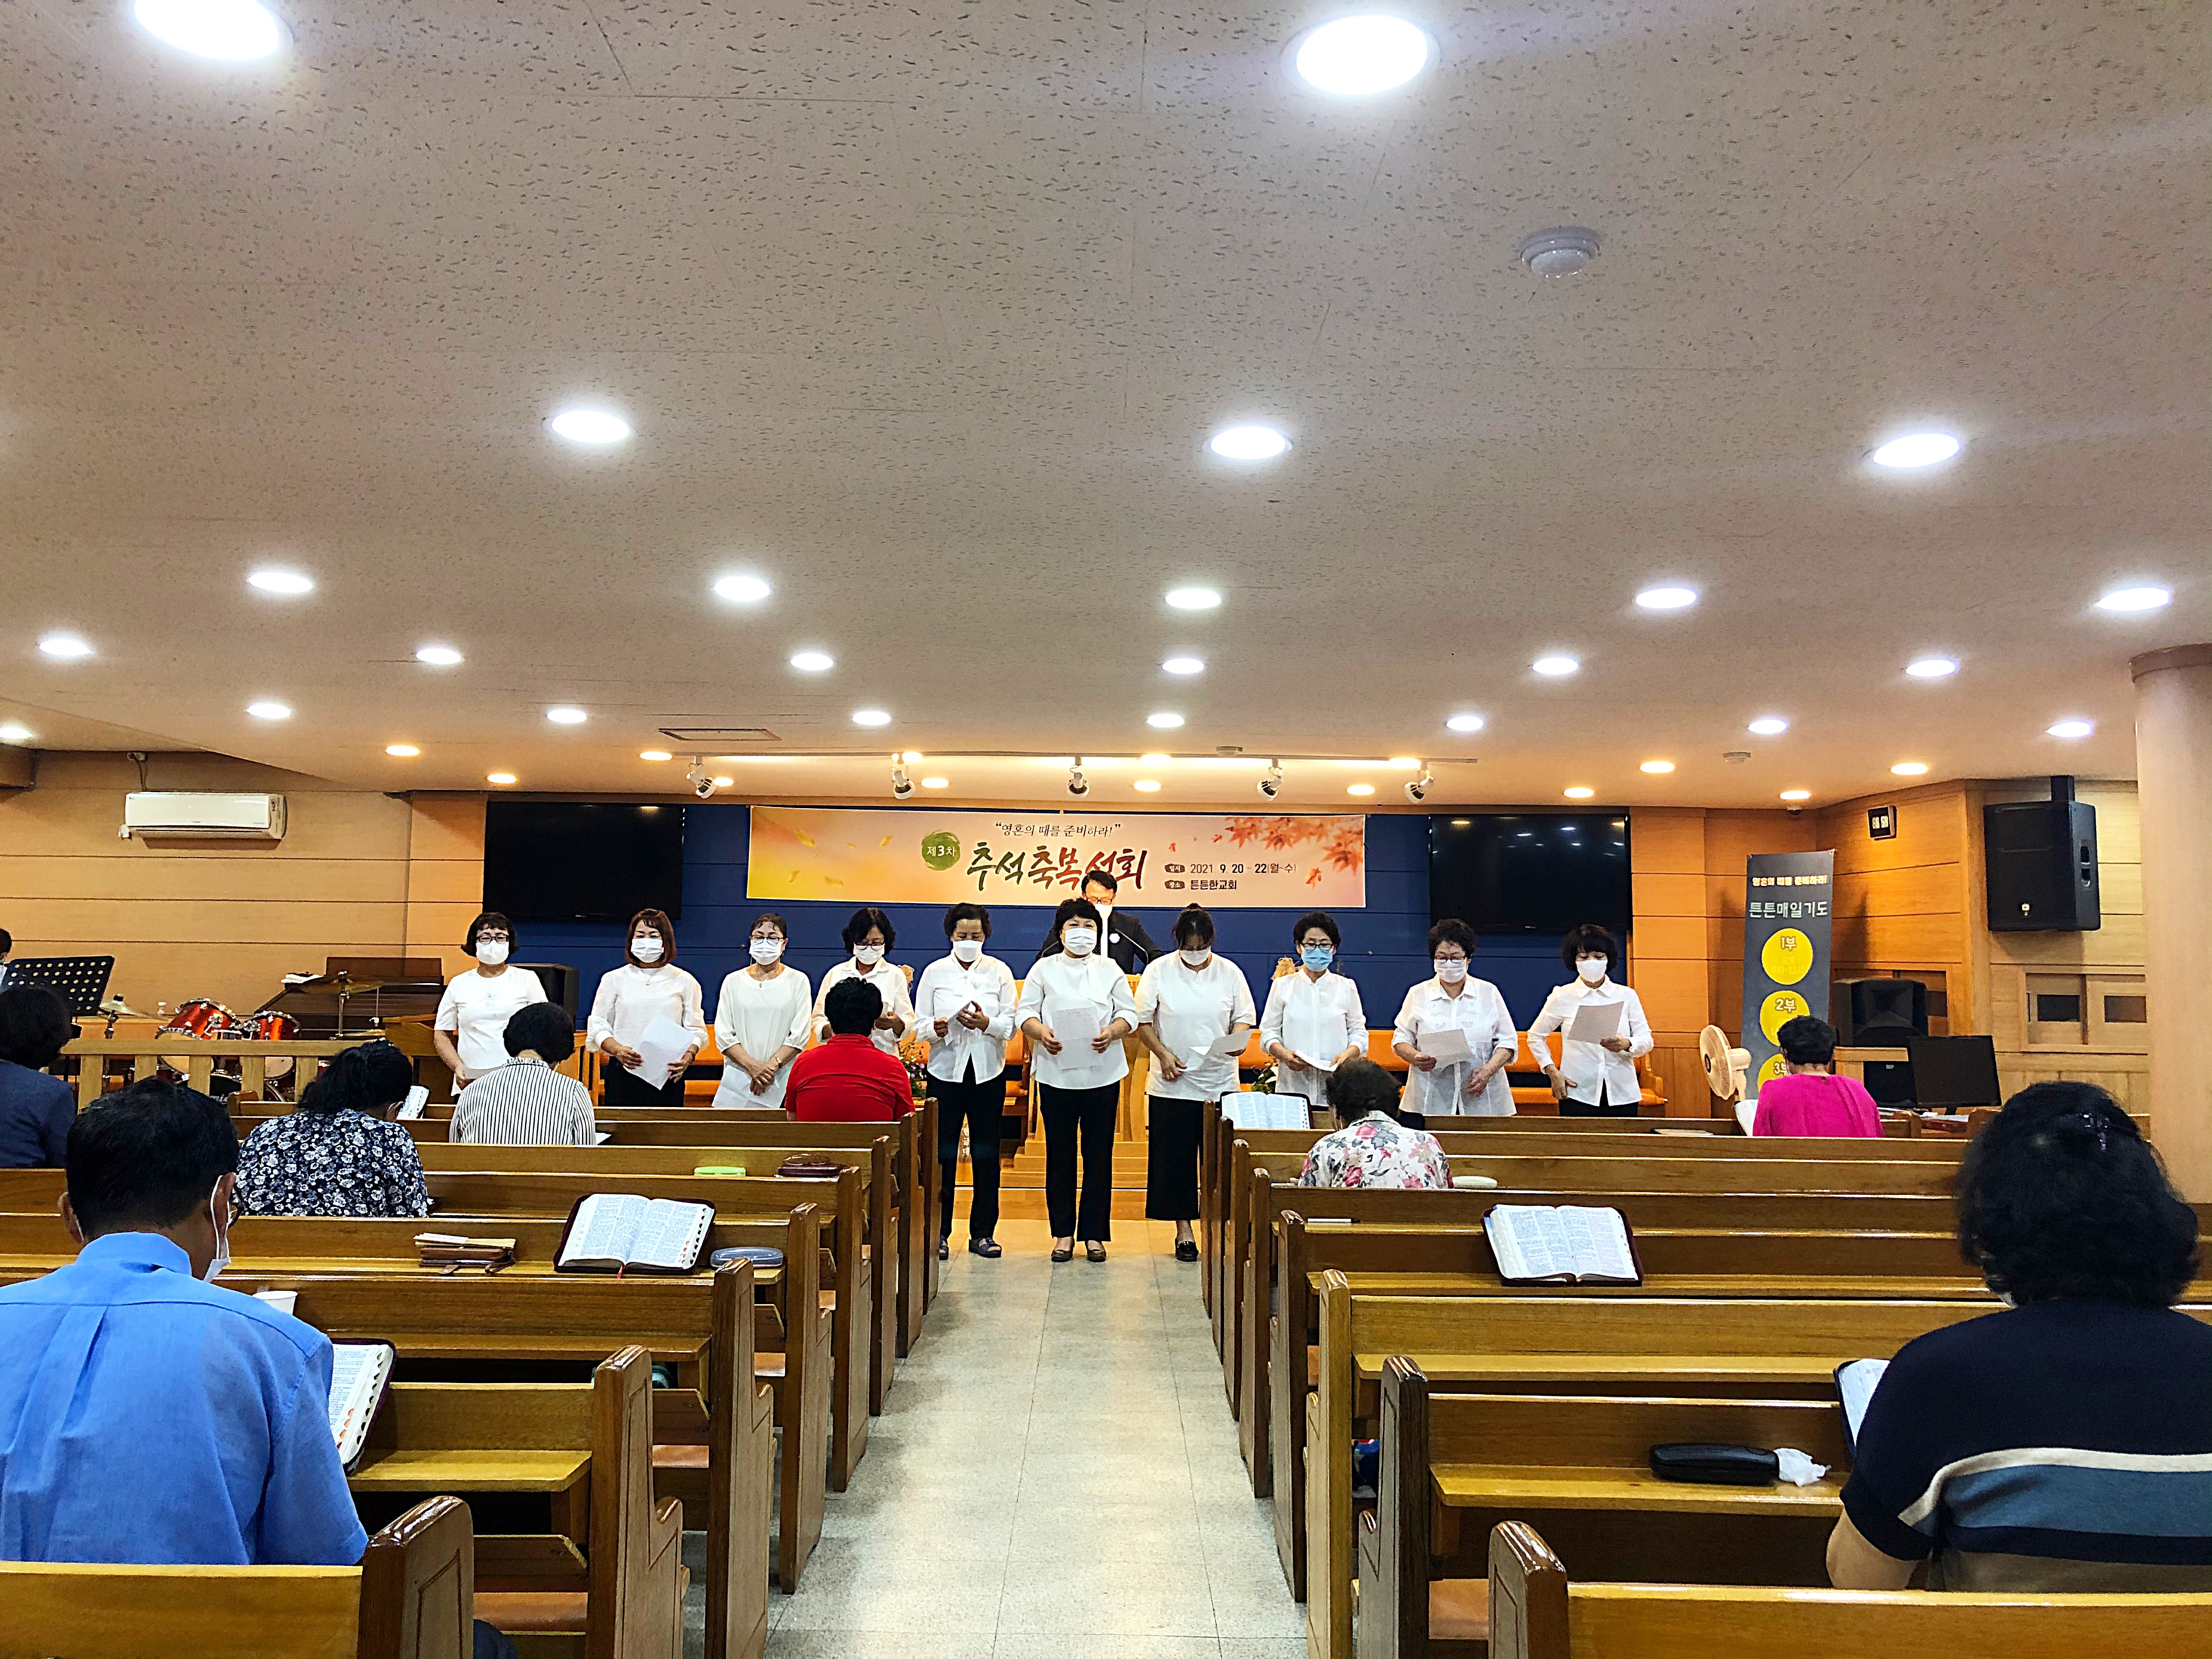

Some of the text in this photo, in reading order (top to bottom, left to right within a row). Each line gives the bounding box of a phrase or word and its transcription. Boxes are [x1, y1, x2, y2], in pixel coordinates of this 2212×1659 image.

[1039, 824, 1060, 837] 때를
[926, 845, 956, 857] 제3차
[1232, 864, 1244, 873] 20
[1190, 879, 1237, 890] 튼튼한교회
[1752, 877, 1775, 886] 영혼의
[1780, 936, 1796, 950] 1부
[1775, 998, 1796, 1013] 2부
